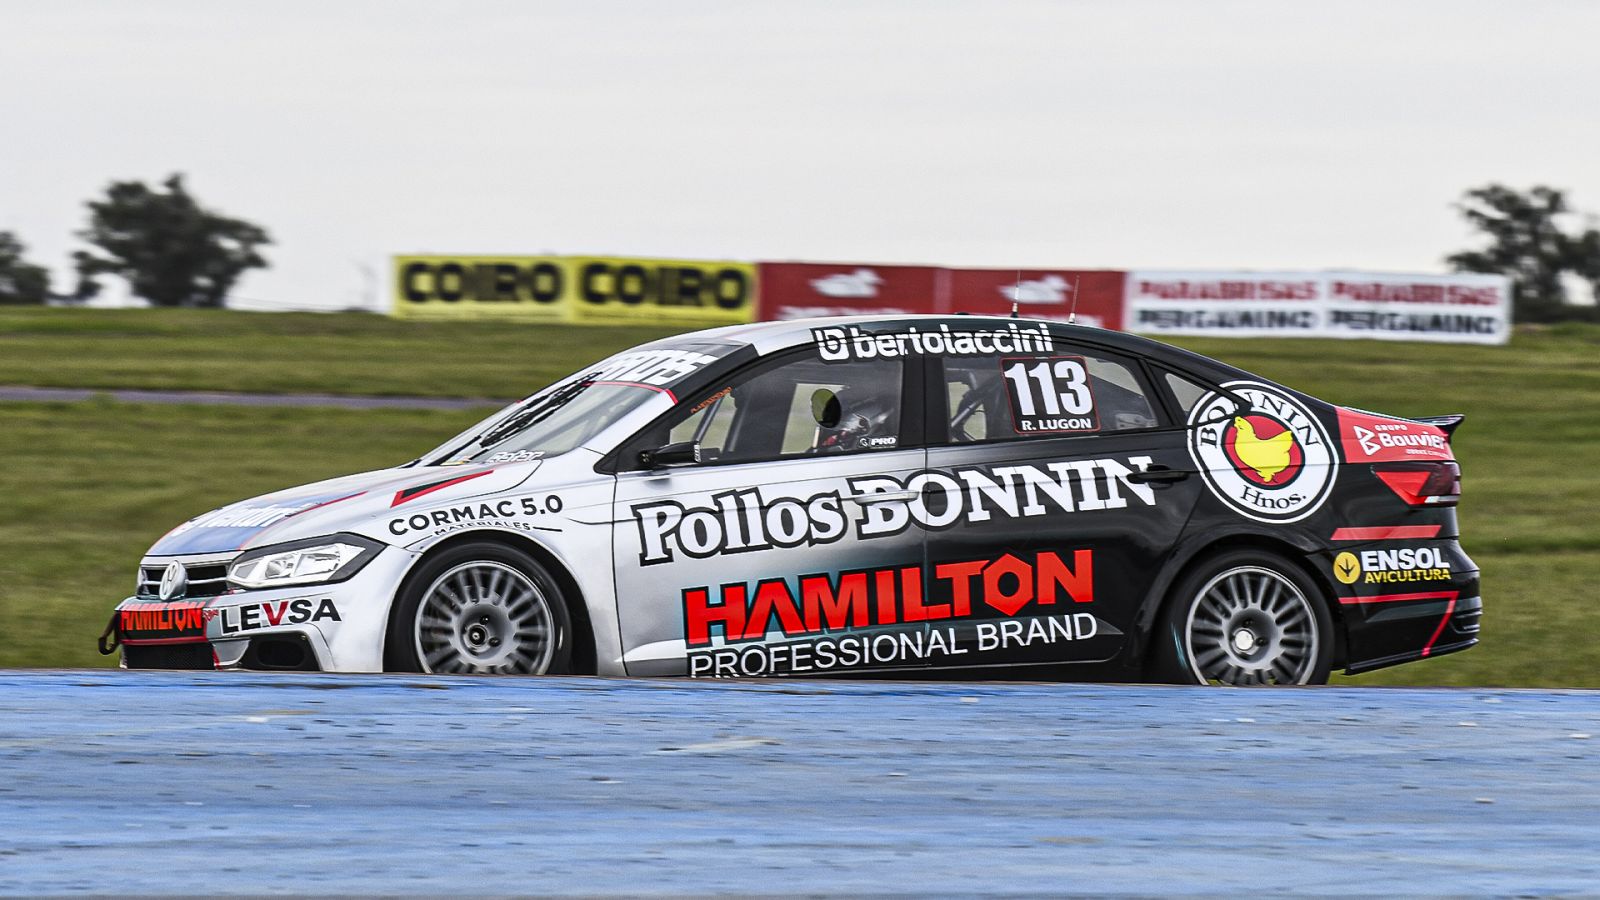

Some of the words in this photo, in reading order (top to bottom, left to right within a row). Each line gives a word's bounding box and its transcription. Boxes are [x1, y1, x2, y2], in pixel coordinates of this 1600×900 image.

[850, 322, 1054, 359] bertolaccini
[1003, 360, 1093, 415] 113
[1021, 420, 1037, 431] R.
[1039, 418, 1092, 430] LUGON
[388, 500, 516, 536] CORMAC
[520, 494, 564, 517] 5.0
[636, 487, 849, 565] Pollos
[851, 455, 1157, 535] BONNIN
[1240, 485, 1307, 509] Hnos.
[434, 520, 531, 537] MATERIALES
[1360, 548, 1451, 571] ENSOL
[1364, 569, 1452, 584] AVICULTURA
[685, 548, 1094, 645] HAMILTON
[120, 601, 206, 632] HAMILTON
[220, 598, 342, 635] LEVSA
[690, 627, 969, 678] PROFESSIONAL
[976, 612, 1098, 651] BRAND
